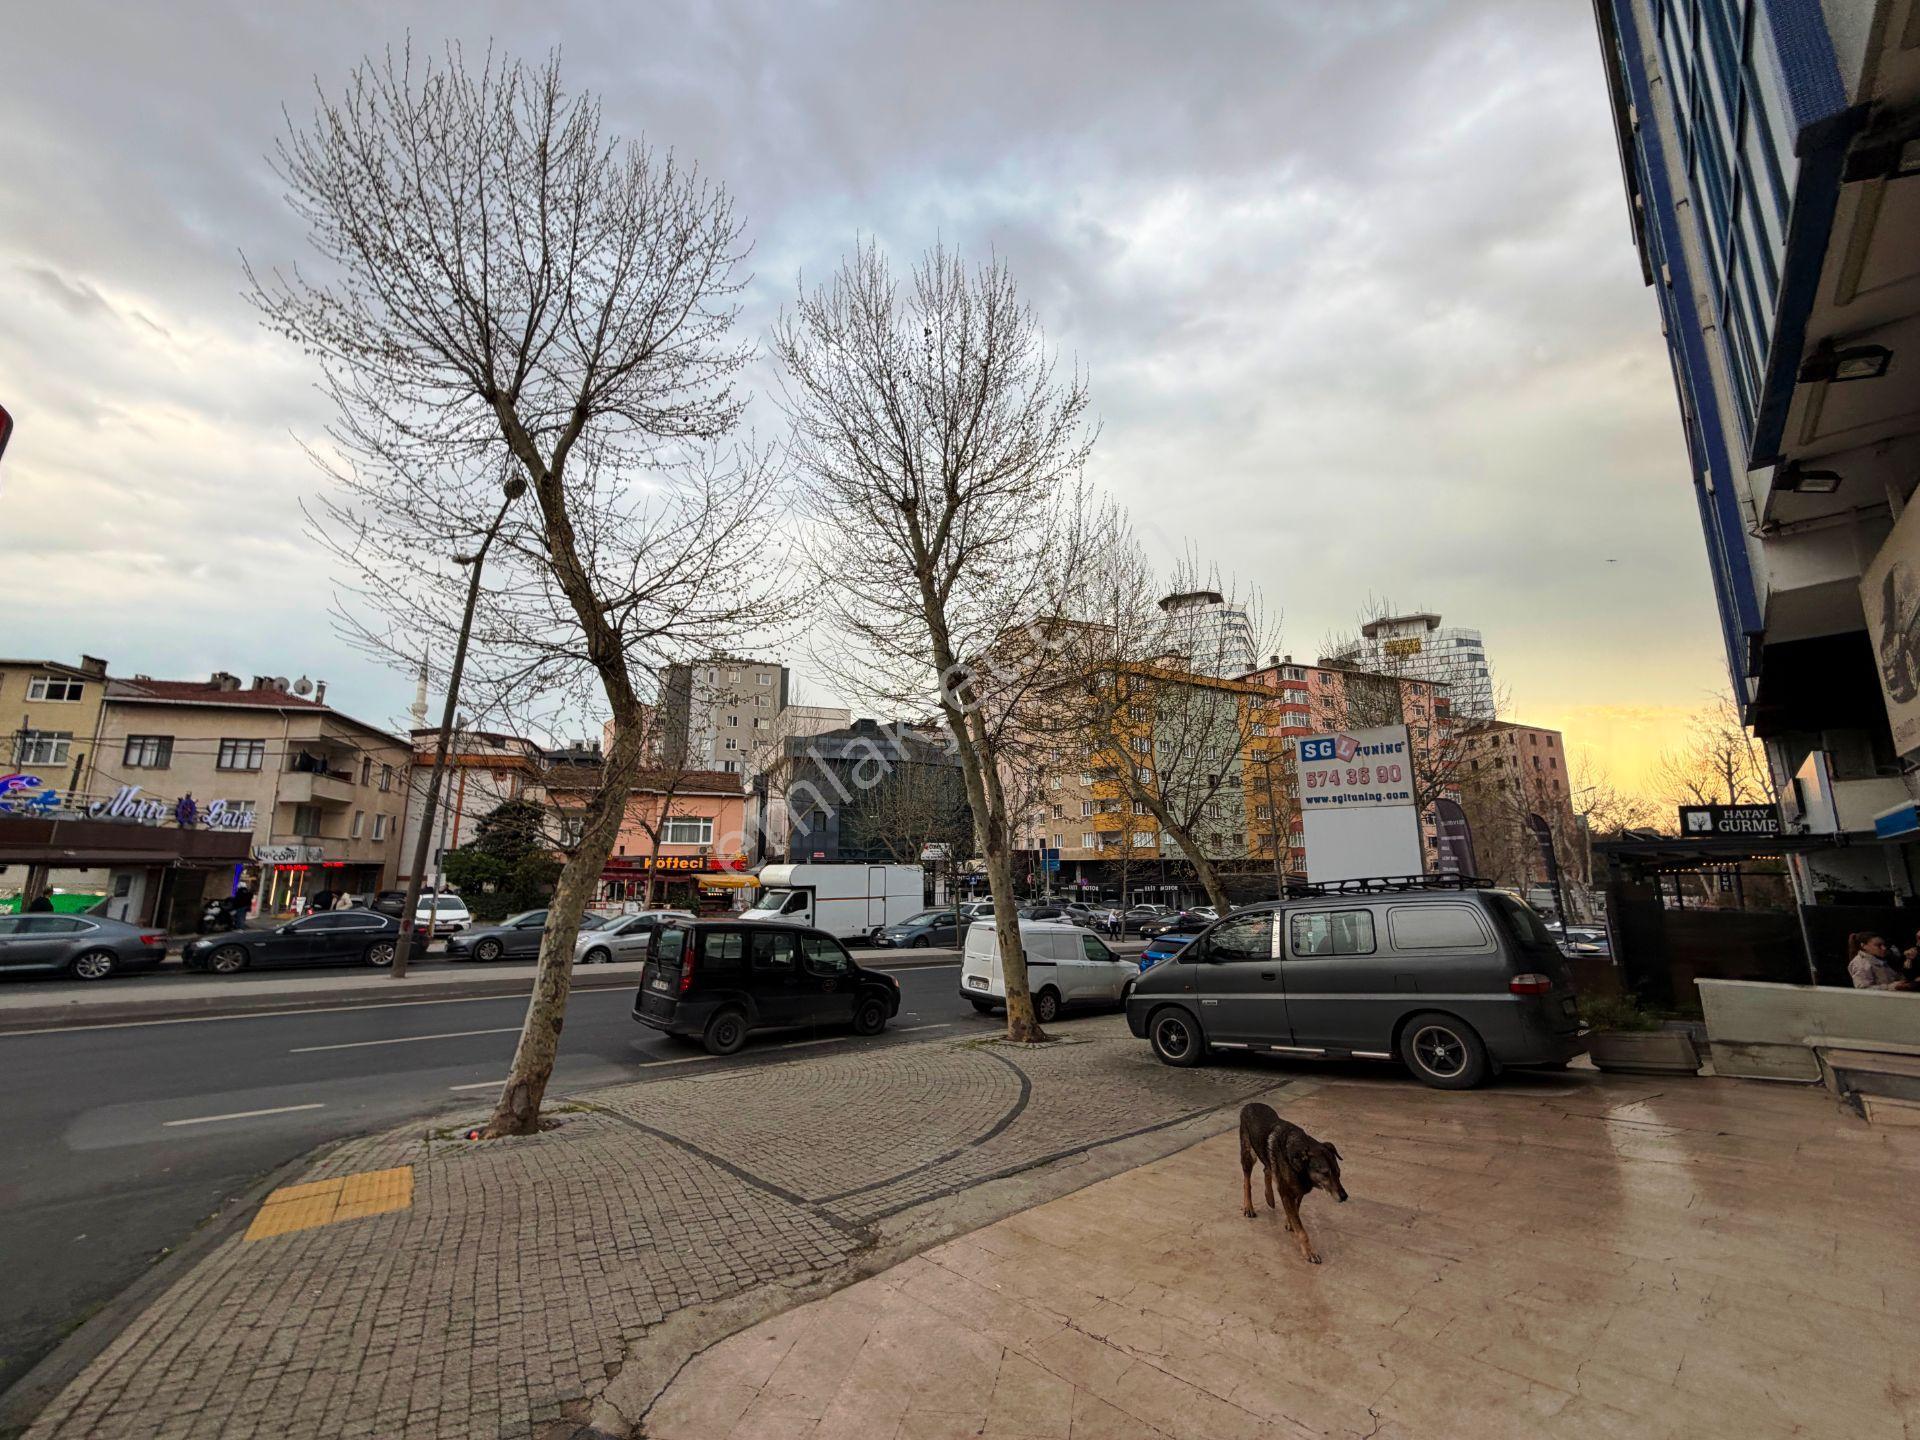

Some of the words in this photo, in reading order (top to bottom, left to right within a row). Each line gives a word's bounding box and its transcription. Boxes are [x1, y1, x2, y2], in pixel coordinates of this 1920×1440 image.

[1306, 769, 1340, 788] 574
[1376, 764, 1401, 784] 90
[89, 785, 167, 821] Nokta
[1306, 791, 1409, 804] www.sgltuning.com
[1724, 810, 1769, 819] HATAY
[1718, 819, 1779, 832] GURME
